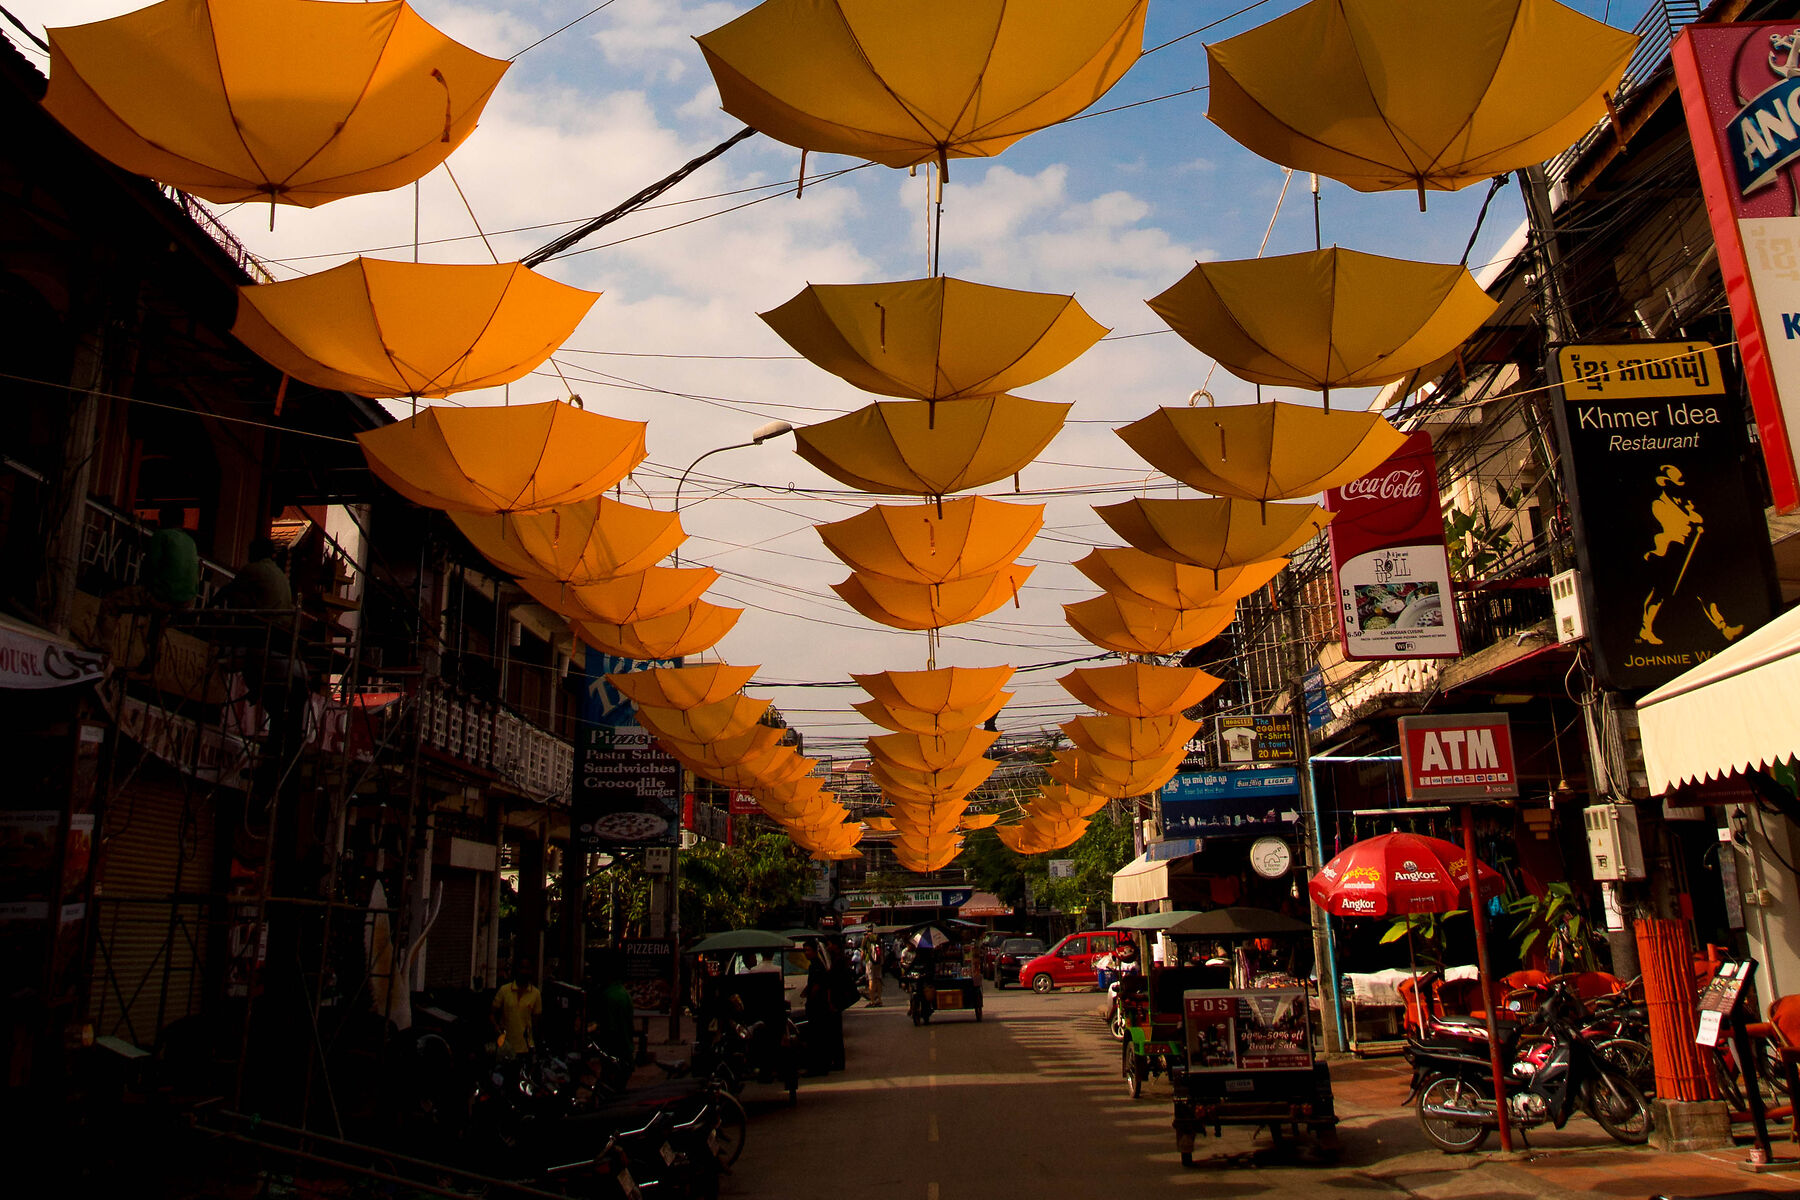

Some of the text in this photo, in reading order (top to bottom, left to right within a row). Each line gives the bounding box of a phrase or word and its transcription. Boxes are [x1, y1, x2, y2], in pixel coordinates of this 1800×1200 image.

[1578, 402, 1720, 430] Khmer Idea
[1609, 432, 1700, 451] Restaurant
[0, 647, 42, 676] OUSE
[1256, 716, 1290, 732] coolest
[591, 729, 660, 745] Pizzer
[1258, 732, 1291, 740] T-Shirts
[1269, 740, 1287, 748] town
[1421, 729, 1499, 771] ATM
[586, 749, 626, 760] Pasta
[1258, 749, 1269, 758] 20
[584, 762, 676, 774] Sandwiches
[584, 777, 666, 788] Crocodile
[637, 786, 676, 798] Burger
[735, 793, 757, 805] Ang
[1395, 871, 1436, 881] Angkor
[1341, 898, 1375, 911] Angkor
[627, 943, 670, 955] PIZZERIA
